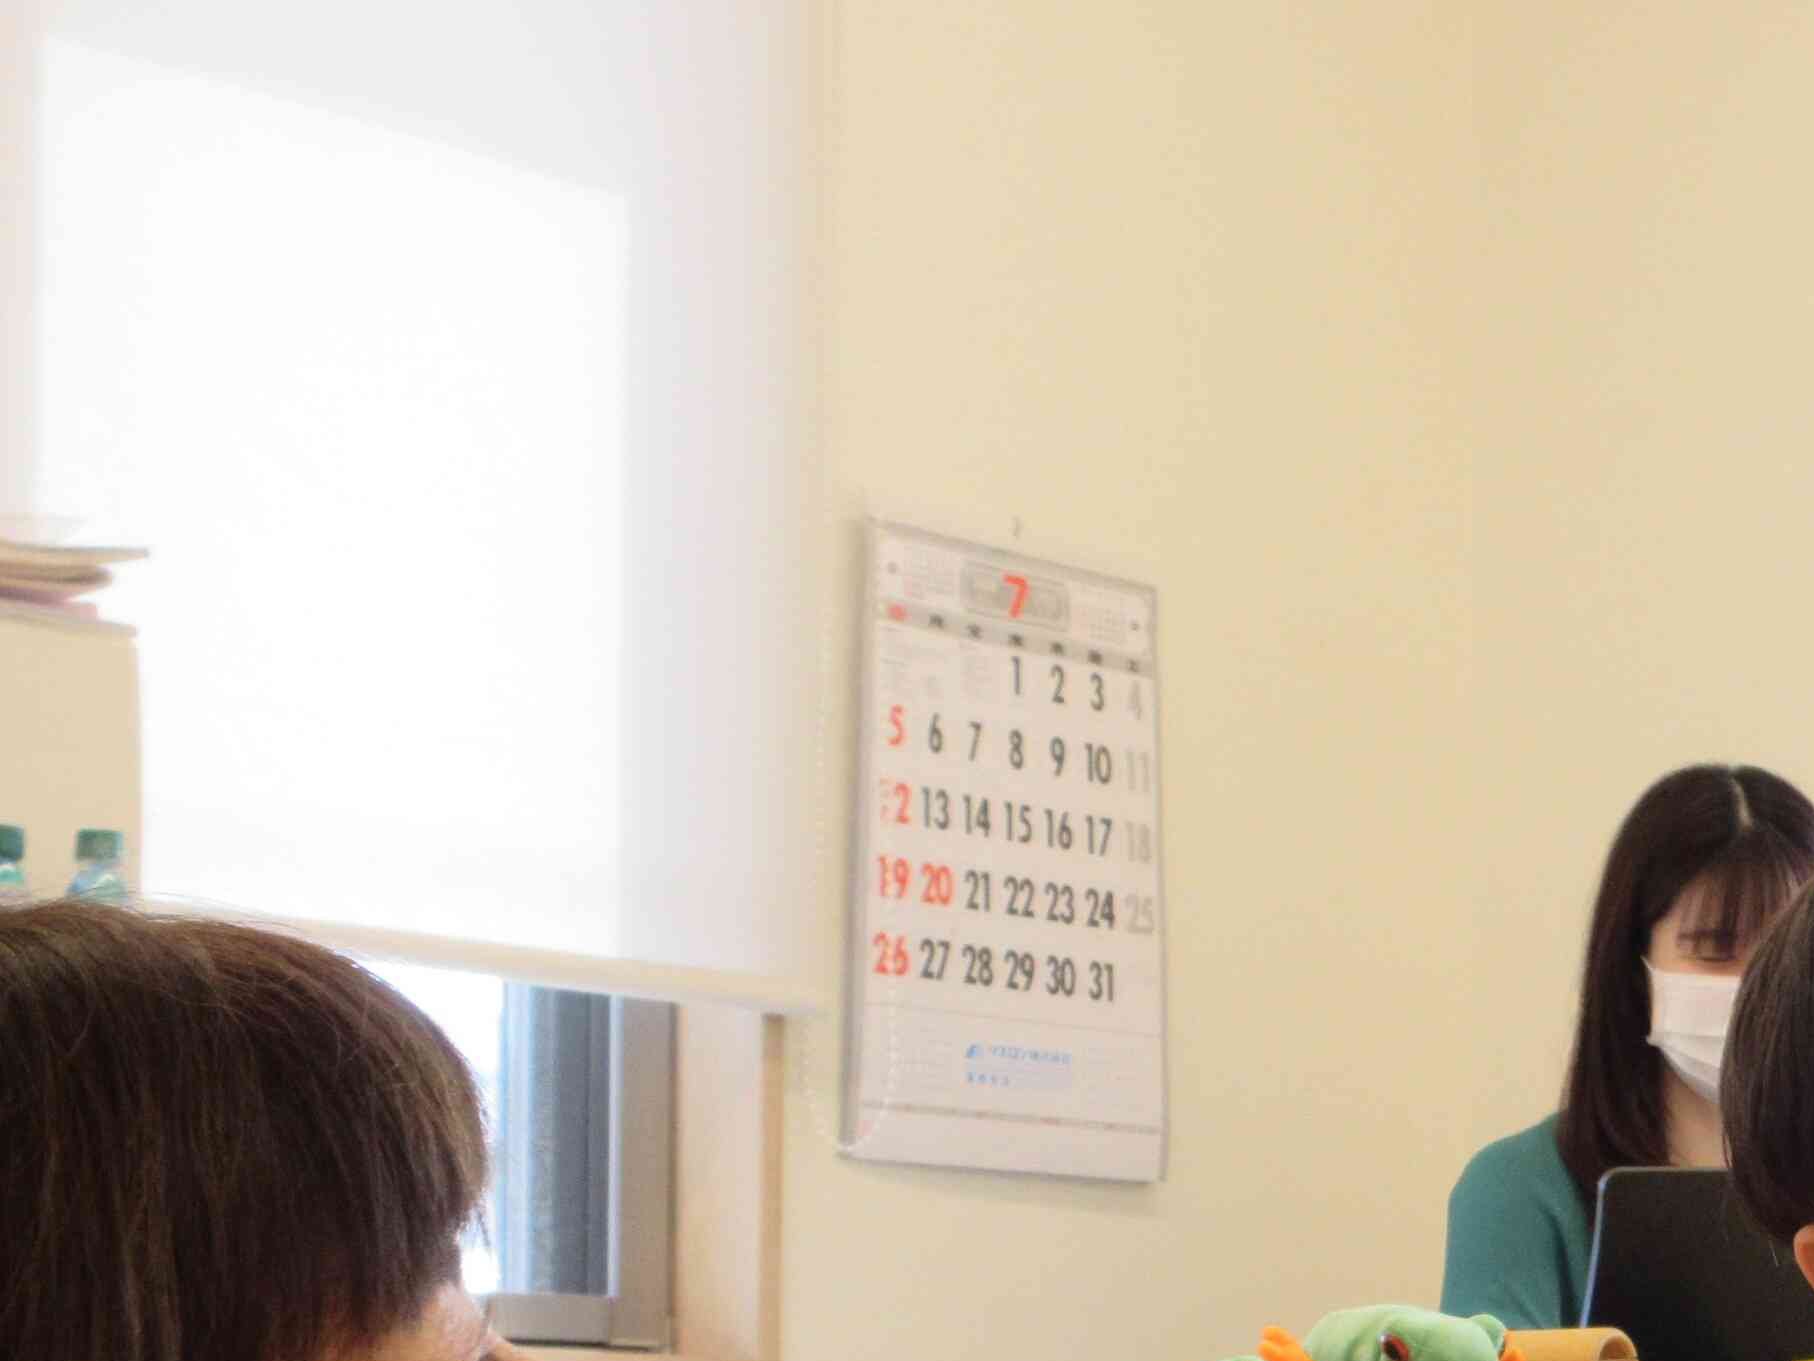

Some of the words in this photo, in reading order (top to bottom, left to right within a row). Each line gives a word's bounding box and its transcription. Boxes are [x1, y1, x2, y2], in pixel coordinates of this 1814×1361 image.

[1005, 575, 1029, 619] 7
[1011, 657, 1022, 695] 1
[1051, 666, 1065, 704] 2
[1090, 674, 1105, 711] 3
[888, 706, 906, 747] 5
[928, 714, 942, 753] 6
[969, 723, 982, 761] 7
[1009, 731, 1024, 769] 8
[1050, 738, 1065, 777] 9
[1084, 744, 1112, 784] 10
[921, 788, 950, 830] 13
[963, 796, 991, 837] 14
[1004, 803, 1032, 843] 15
[1044, 810, 1072, 850] 16
[1086, 817, 1113, 856] 17
[877, 857, 910, 899] 19
[921, 865, 953, 907] 20
[965, 871, 991, 913] 21
[1004, 878, 1035, 918] 22
[1045, 884, 1075, 925] 23
[1085, 890, 1115, 930] 24
[873, 933, 910, 976] 26
[920, 940, 951, 981] 27
[962, 946, 994, 987] 28
[1004, 952, 1035, 992] 29
[1045, 957, 1076, 997] 30
[1088, 964, 1115, 1002] 31
